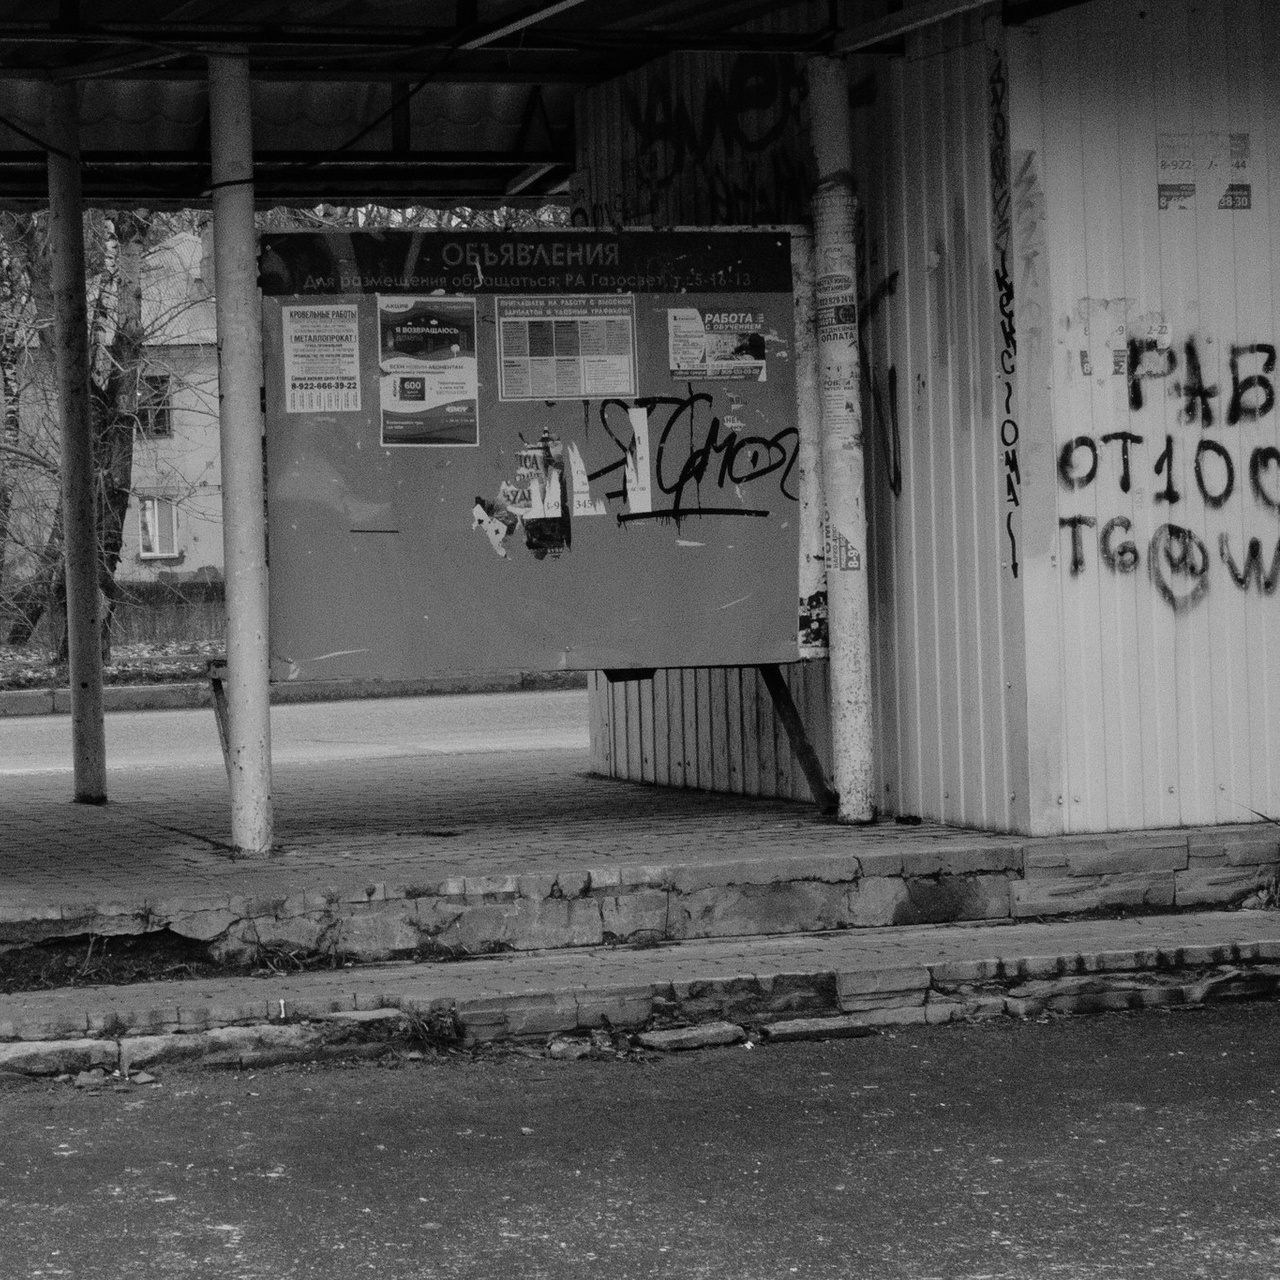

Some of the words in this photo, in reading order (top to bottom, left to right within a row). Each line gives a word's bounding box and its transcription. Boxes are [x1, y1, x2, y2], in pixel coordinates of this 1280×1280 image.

[441, 242, 619, 266] ОБЪЯВЛЕНИЯ
[303, 274, 336, 290] Для
[340, 275, 447, 290] размещения
[565, 274, 586, 288] РА
[289, 310, 330, 319] КРОВЕЛЬНЫЕ
[331, 310, 357, 319] РАБОТЫ
[705, 313, 753, 324] РАБОТА
[293, 334, 352, 342] МЕТАЛЛОПРОКАТ
[821, 332, 854, 342] ОПЛАТА
[404, 381, 421, 389] 600
